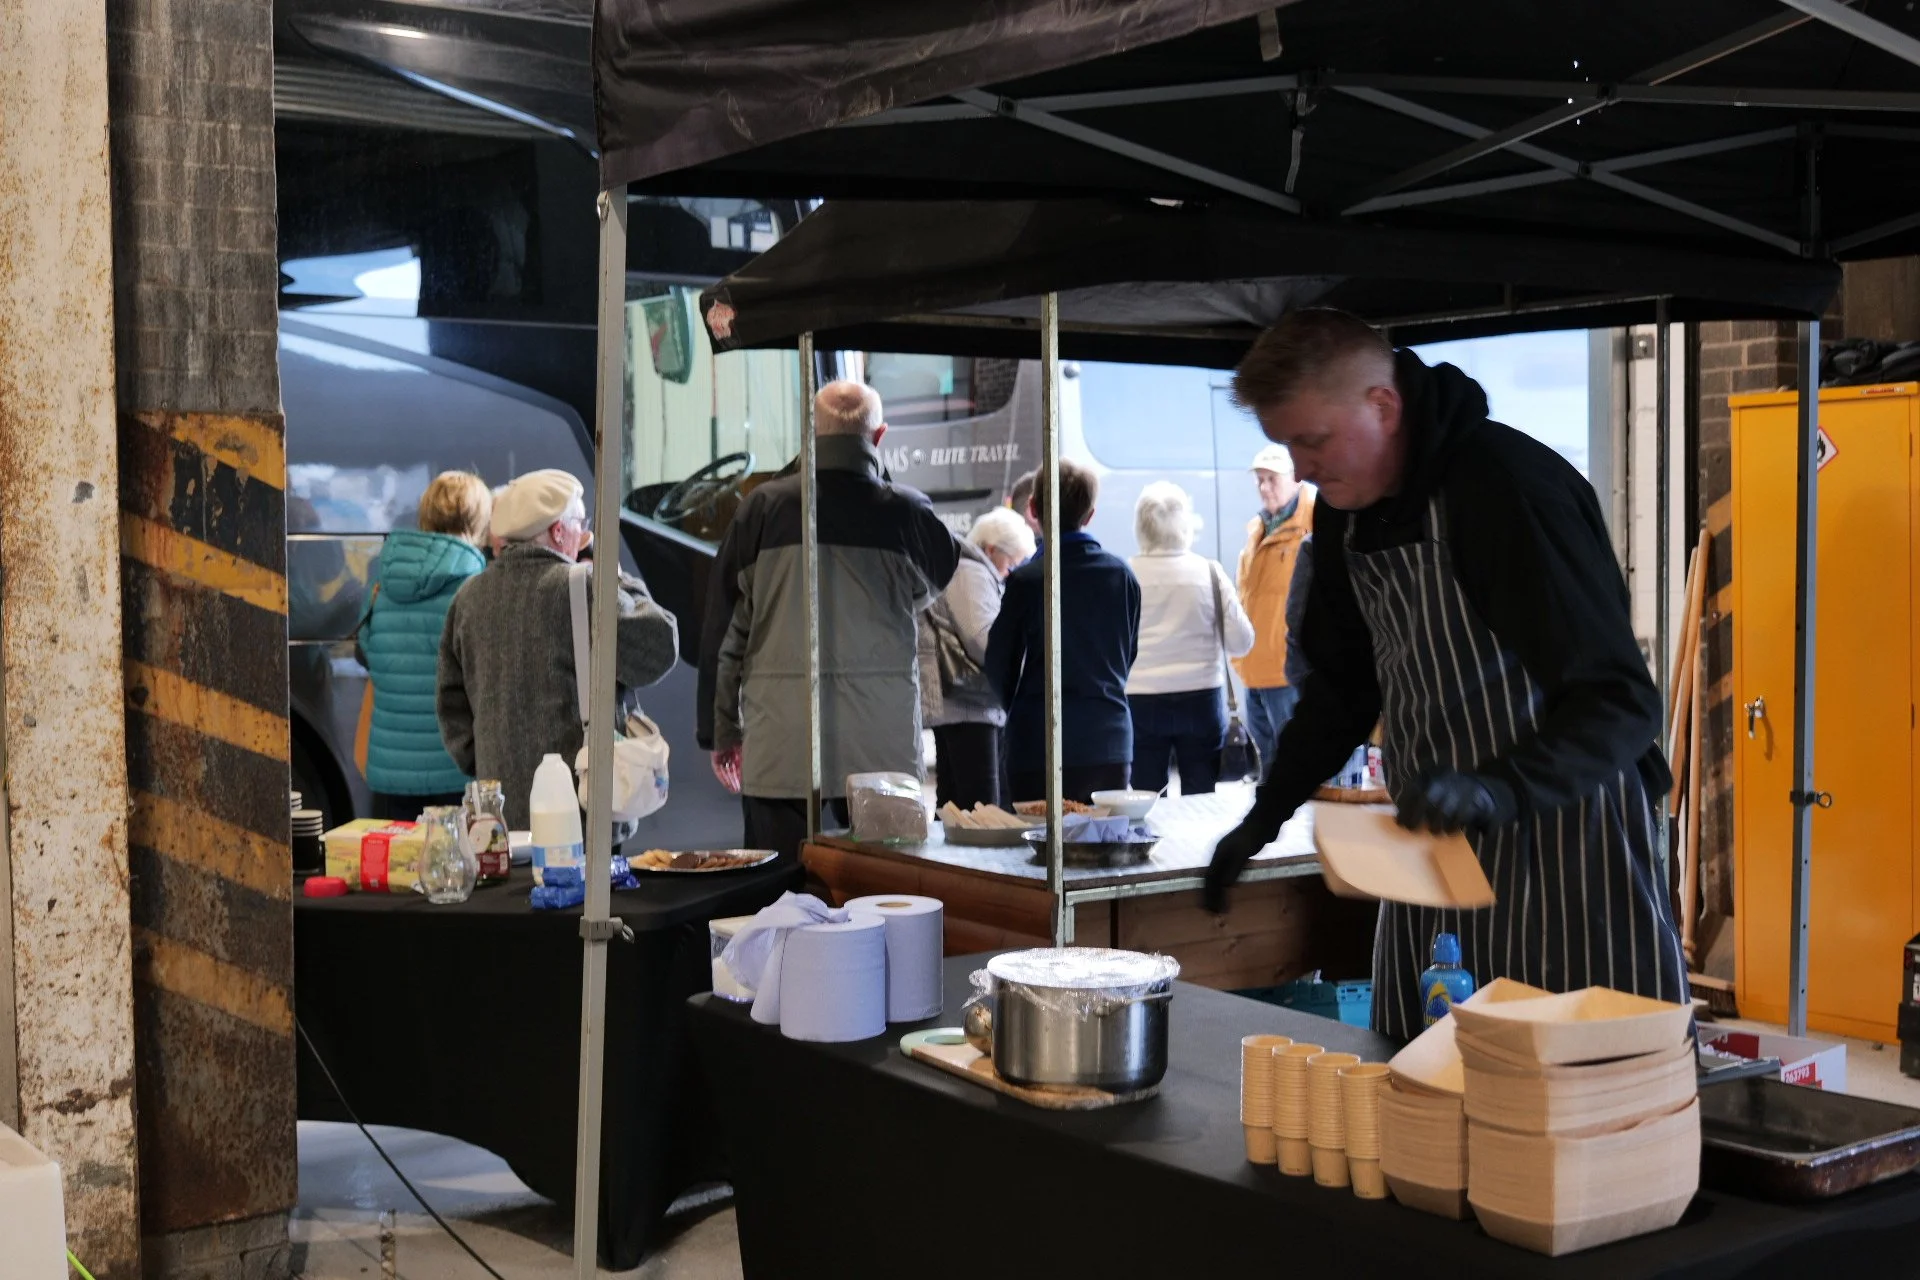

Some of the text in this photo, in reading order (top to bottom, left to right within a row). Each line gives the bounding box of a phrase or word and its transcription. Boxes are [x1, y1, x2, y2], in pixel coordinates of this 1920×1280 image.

[878, 443, 1020, 473] MS ELITE TRAVEL
